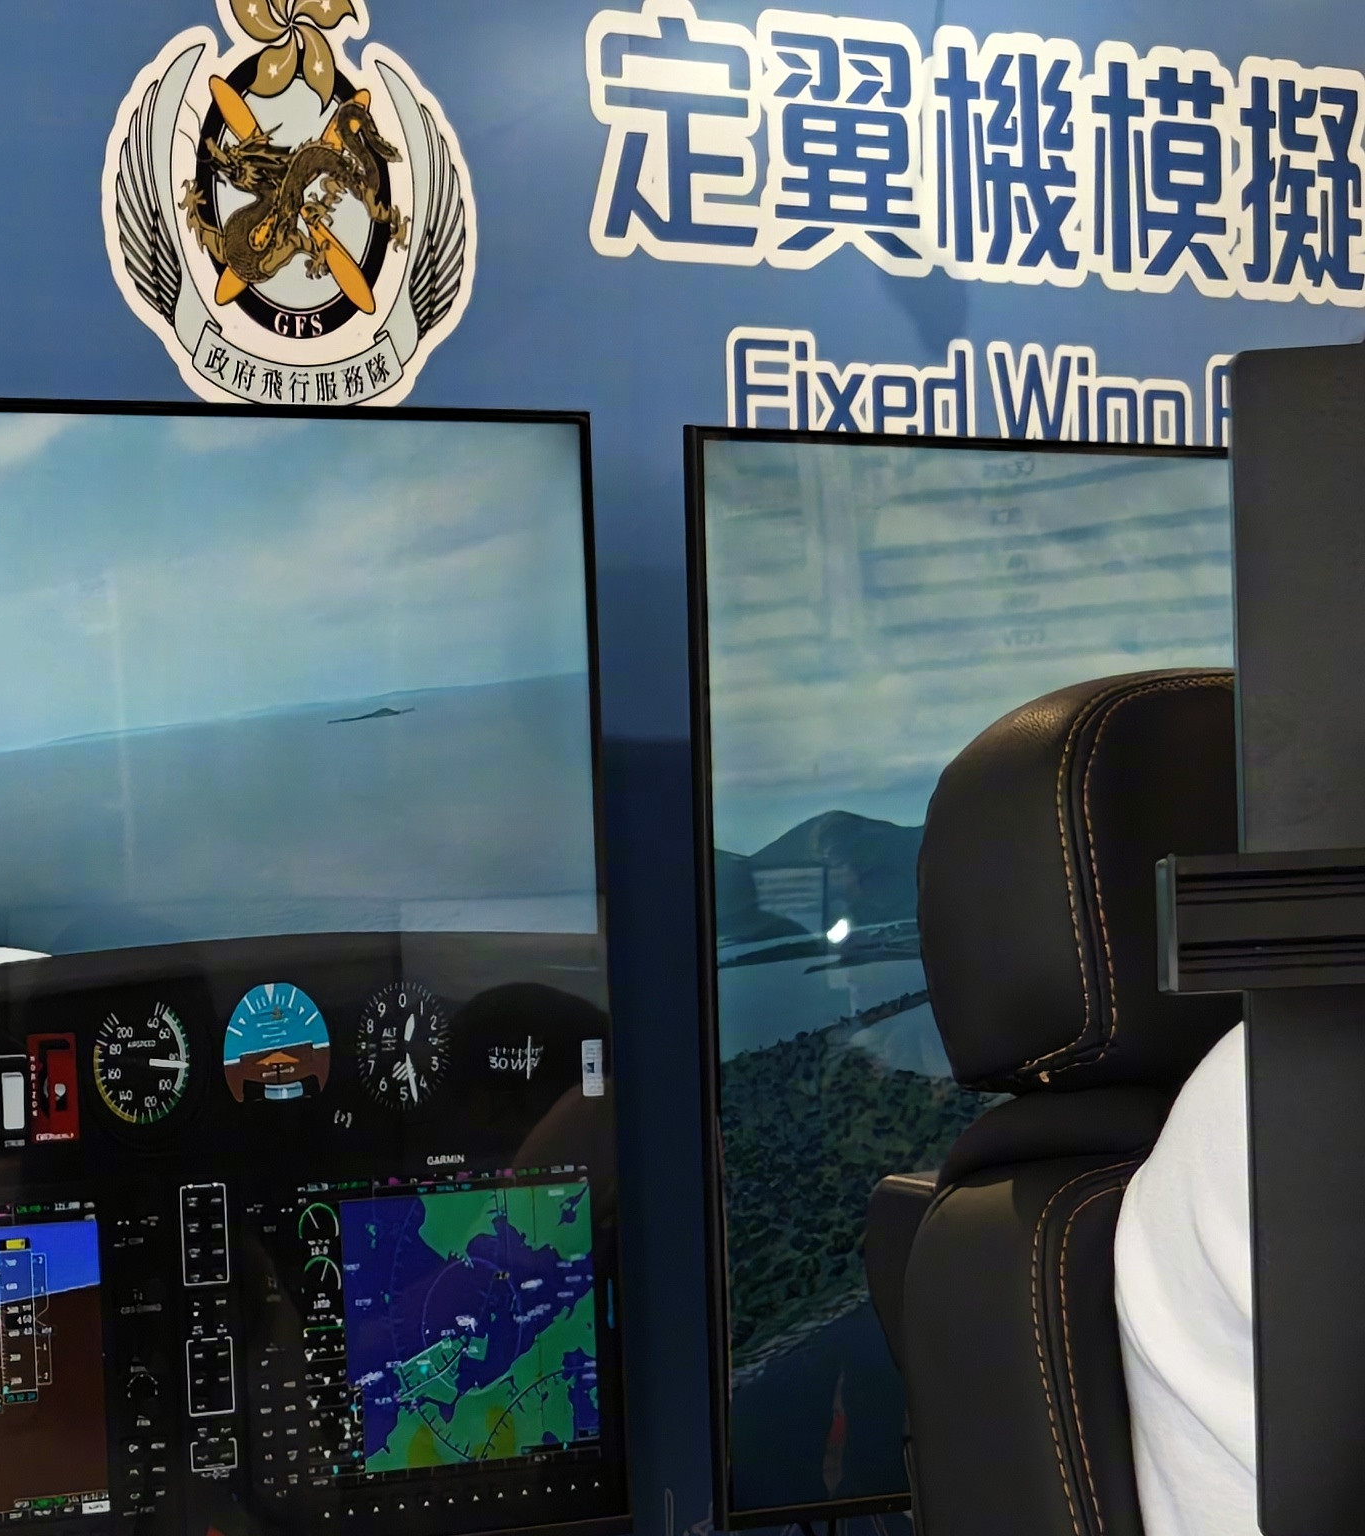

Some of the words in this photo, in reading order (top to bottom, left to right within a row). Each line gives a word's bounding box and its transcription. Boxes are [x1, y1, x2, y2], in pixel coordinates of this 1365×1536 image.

[600, 16, 1365, 290] 定翼機模擬
[274, 313, 323, 338] GFS
[204, 342, 393, 403] 政府飛行服務隊
[116, 1026, 134, 1039] 200
[426, 1154, 465, 1166] GARMIN
